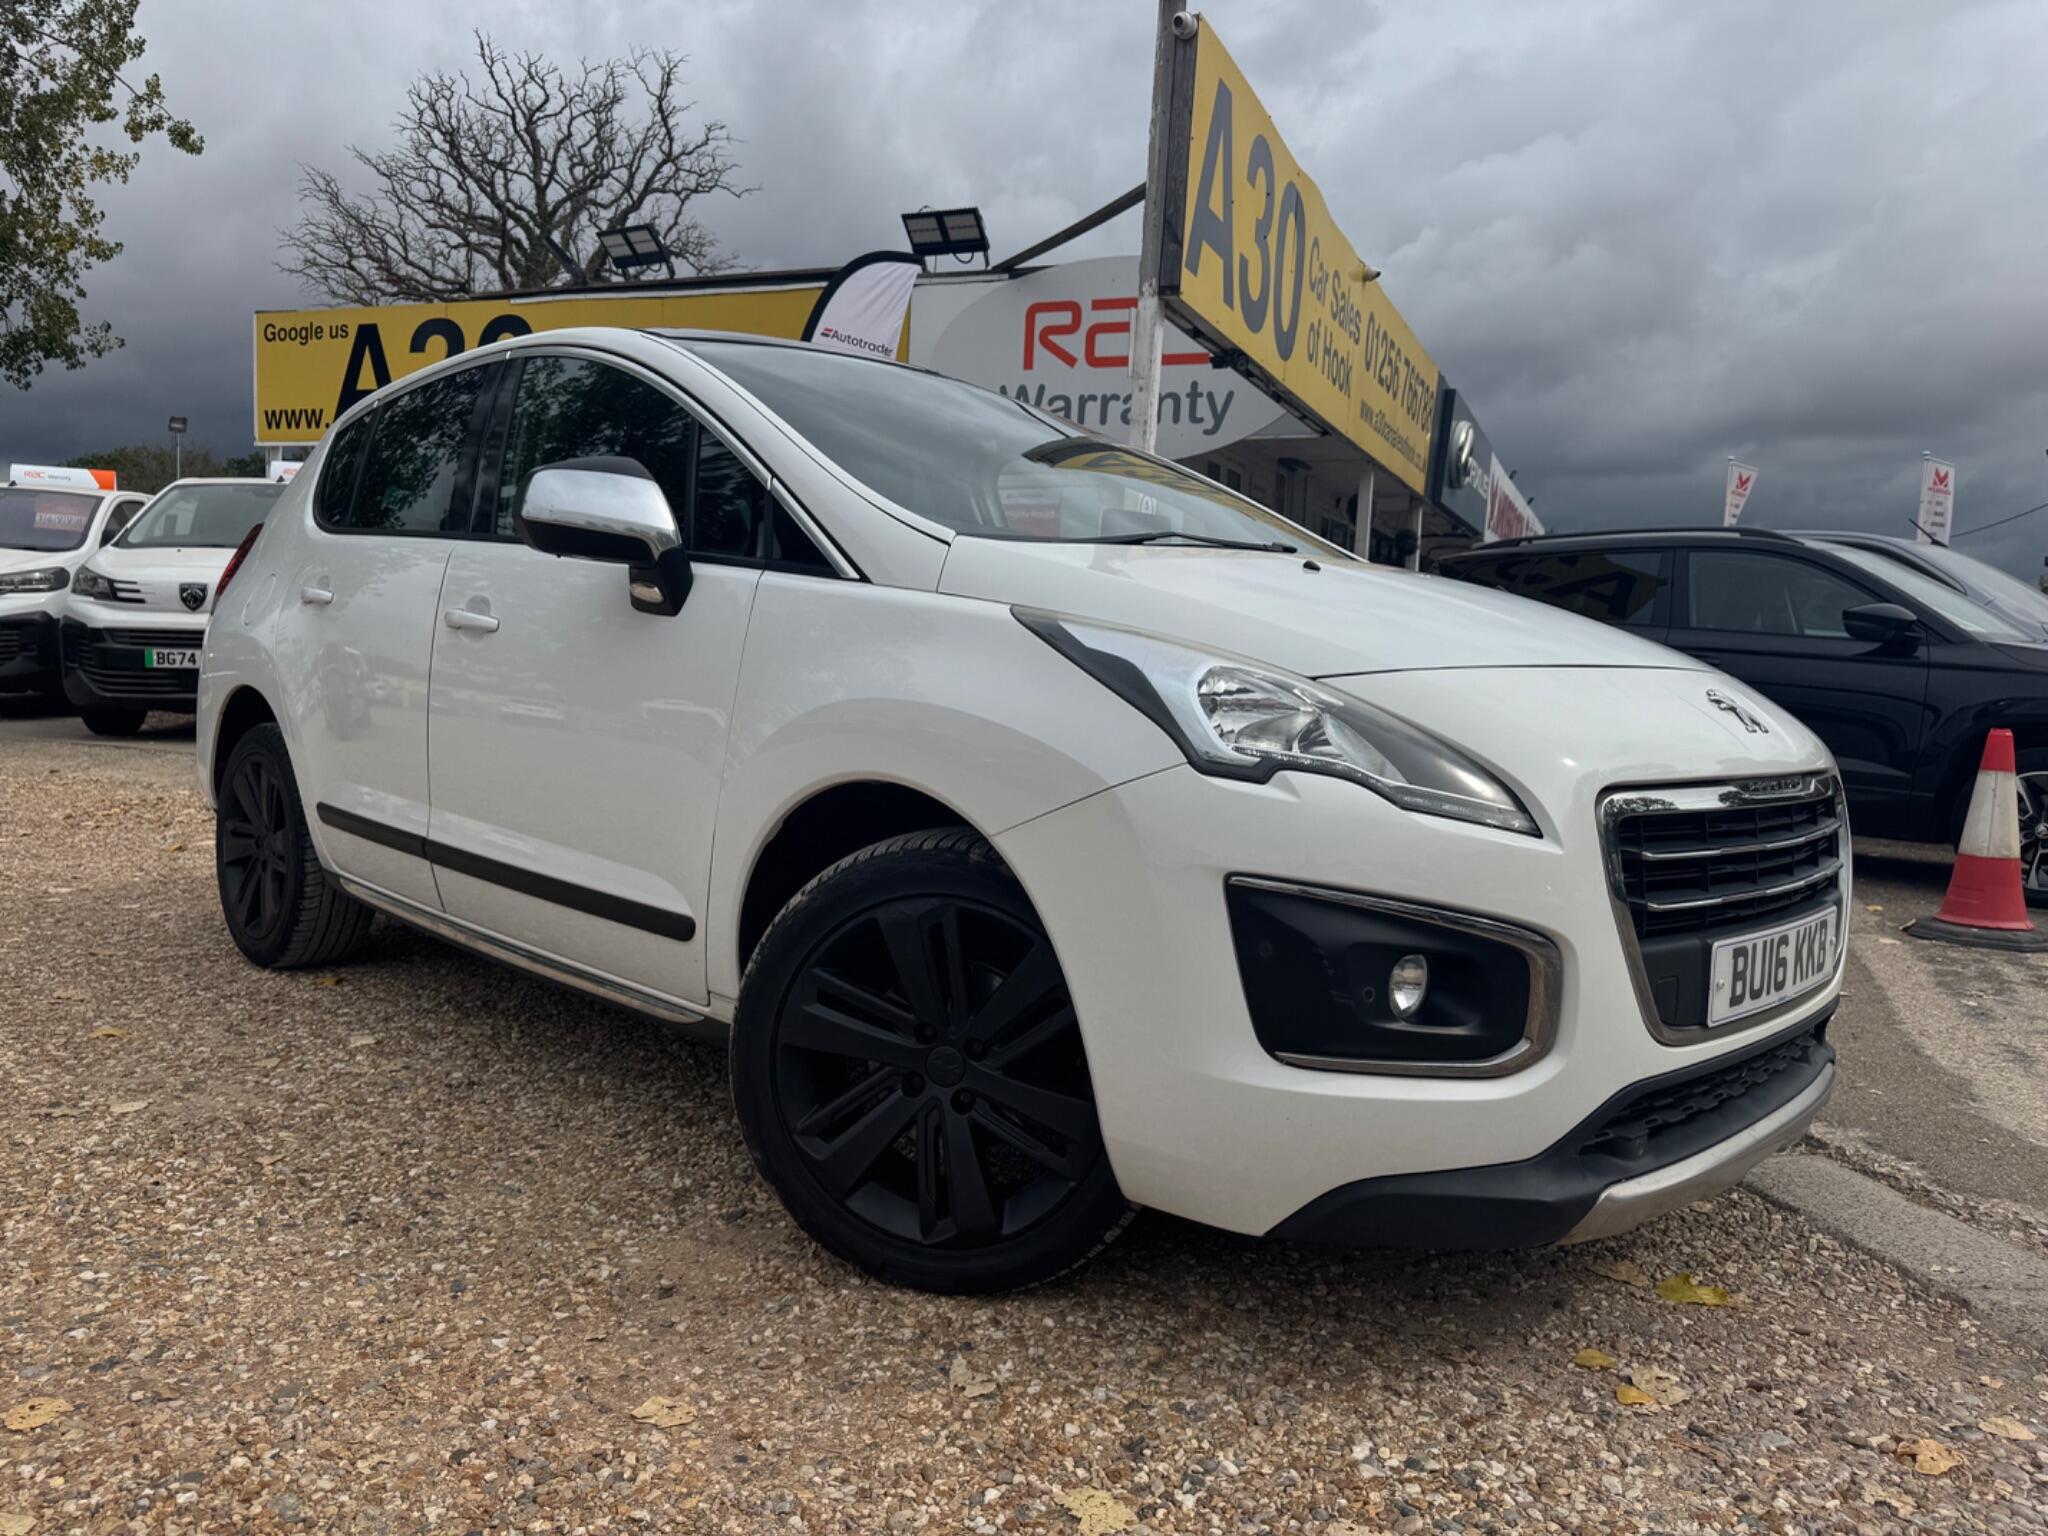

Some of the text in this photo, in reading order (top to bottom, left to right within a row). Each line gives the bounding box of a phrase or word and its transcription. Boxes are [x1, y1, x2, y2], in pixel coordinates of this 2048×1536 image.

[1185, 77, 1306, 362] A30
[263, 321, 349, 346] Google us
[1309, 236, 1361, 346] Car Sales
[830, 330, 894, 357] Autotrader
[1307, 317, 1352, 400] of Hook
[1364, 311, 1401, 401] 01256
[156, 651, 197, 667] BG74
[1729, 918, 1828, 1009] BU16 KKB
